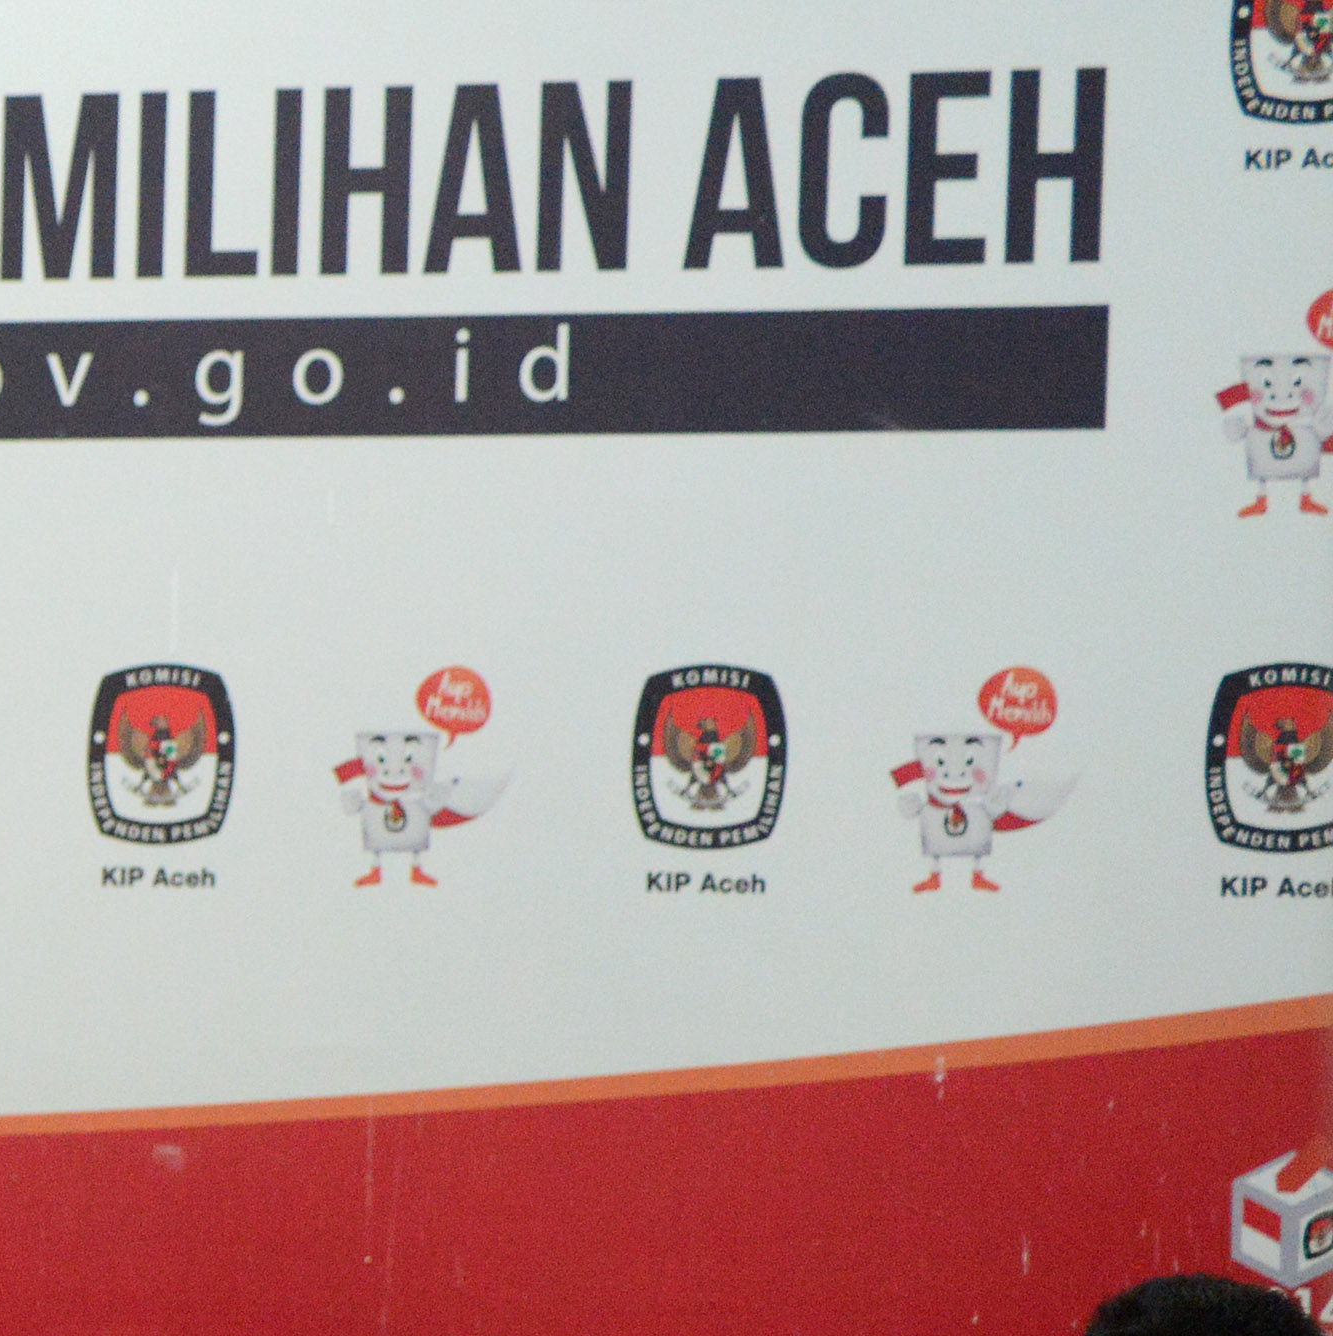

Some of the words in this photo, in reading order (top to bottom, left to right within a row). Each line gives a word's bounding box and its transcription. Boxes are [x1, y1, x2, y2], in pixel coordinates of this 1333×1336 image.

[682, 67, 1108, 271] ACEH
[1245, 148, 1292, 170] KIP
[1302, 148, 1333, 168] Ac
[123, 667, 200, 686] KOMISI
[669, 668, 751, 688] KOMISI
[1001, 672, 1038, 702] Ayo
[1249, 667, 1330, 688] KOMISI
[635, 763, 713, 846] INDEPENDEN
[718, 763, 783, 846] PEMILIHAN
[1208, 765, 1291, 849] INDEPENDEN
[101, 867, 145, 886] KIP
[153, 868, 215, 887] Aceh
[646, 873, 691, 892] KIP
[701, 873, 767, 893] Aceh
[1220, 876, 1268, 896] KIP
